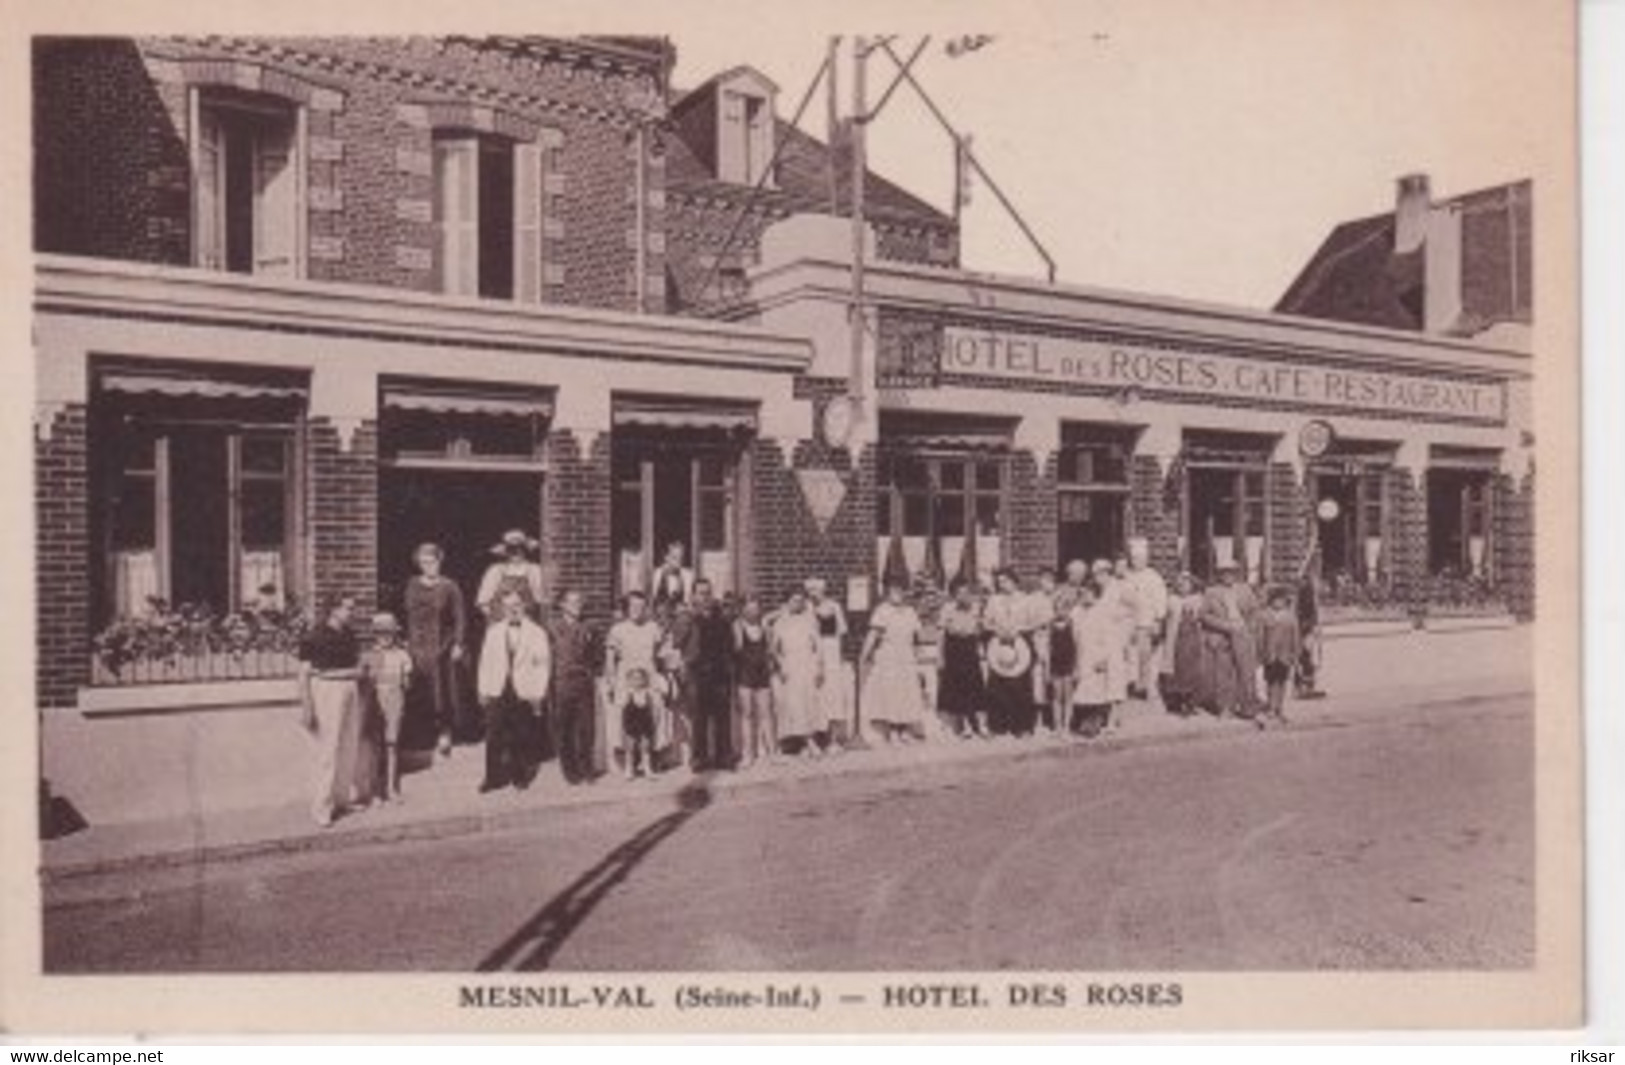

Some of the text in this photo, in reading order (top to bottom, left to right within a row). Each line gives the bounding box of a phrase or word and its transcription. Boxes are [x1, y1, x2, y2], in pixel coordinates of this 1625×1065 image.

[1061, 356, 1101, 378] DES
[1109, 350, 1218, 389] ROSES
[1325, 372, 1482, 412] RESTAURANT
